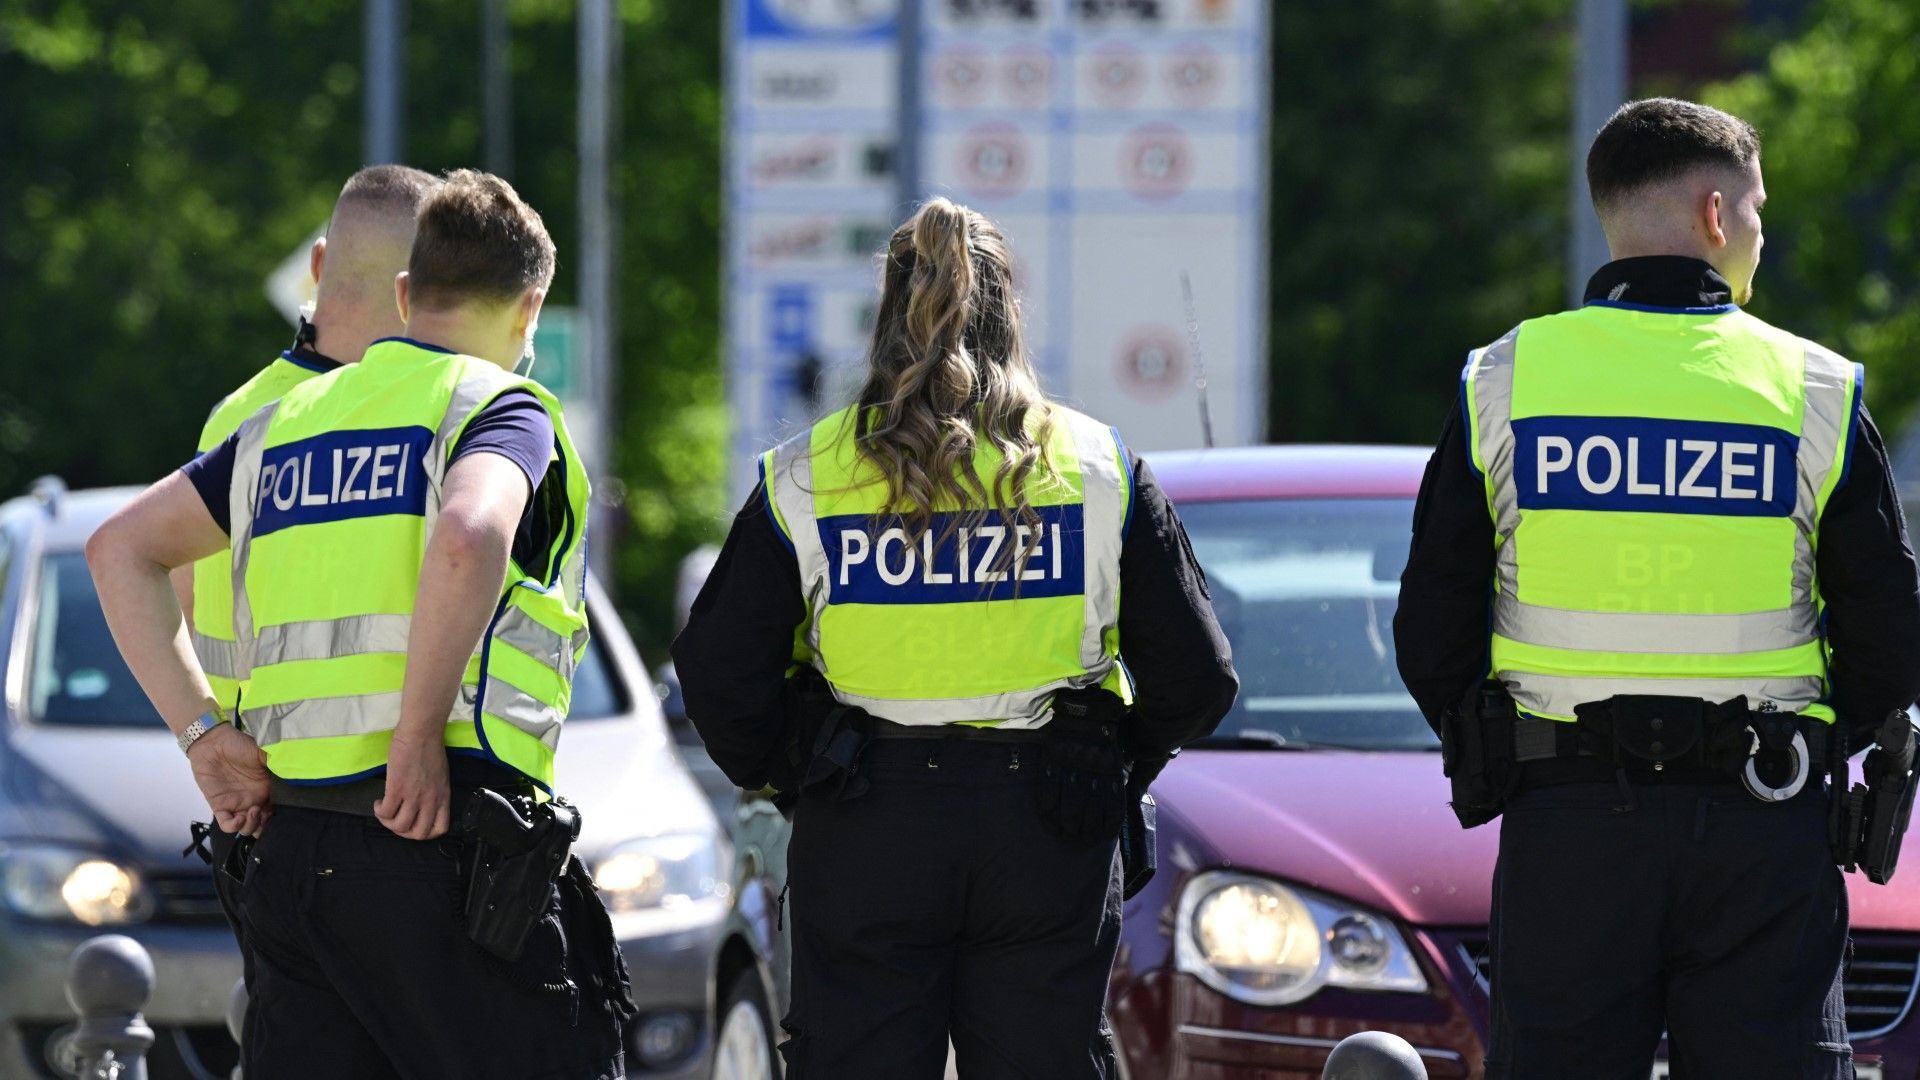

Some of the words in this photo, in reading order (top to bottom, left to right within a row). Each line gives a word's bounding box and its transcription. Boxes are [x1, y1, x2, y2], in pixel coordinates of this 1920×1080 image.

[254, 443, 411, 519] POLIZEI
[1536, 435, 1775, 502] POLIZEI
[839, 523, 1062, 586] POLIZEI
[1616, 542, 1694, 587] BP
